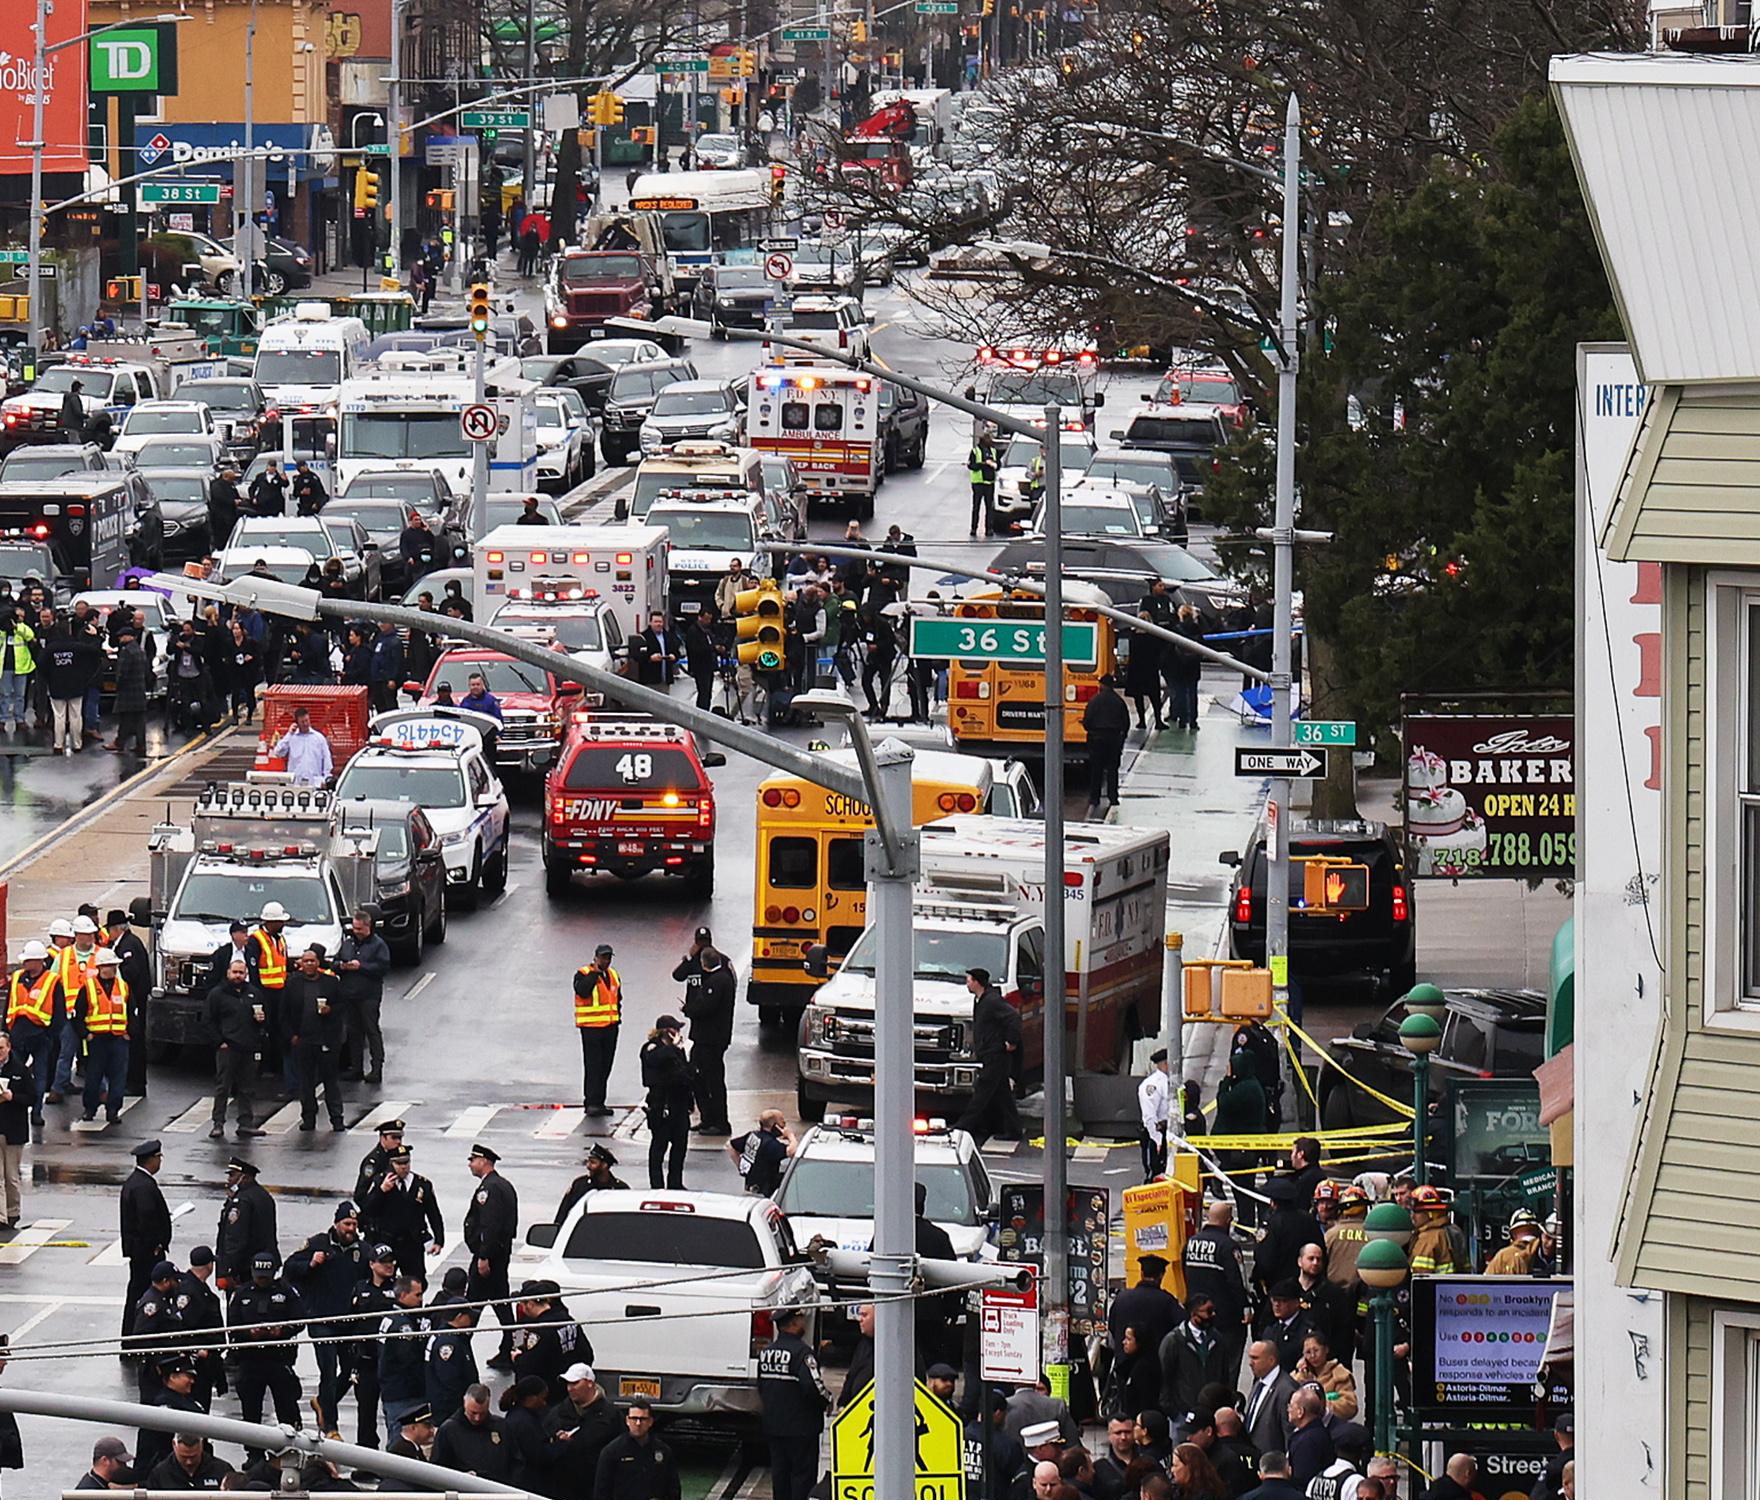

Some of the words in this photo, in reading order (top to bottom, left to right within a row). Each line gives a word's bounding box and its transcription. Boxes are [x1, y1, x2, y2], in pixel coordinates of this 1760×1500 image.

[96, 41, 152, 80] TD
[161, 188, 178, 200] 38
[185, 188, 201, 200] St
[782, 431, 841, 440] AMBULANCE
[959, 627, 998, 651] 36
[1302, 725, 1323, 742] 36
[1330, 724, 1347, 738] ST
[1248, 757, 1275, 768] ONE
[1286, 757, 1313, 768] WAY
[570, 800, 617, 821] FDNY
[1484, 794, 1534, 816] OPEN
[1540, 794, 1561, 816] 24
[1523, 1172, 1556, 1187] MEDICAL
[1187, 1239, 1216, 1253] NYPD
[1504, 1294, 1550, 1306] Brooklyn
[1511, 1307, 1550, 1318] incident
[1438, 1357, 1467, 1368] Buses
[1469, 1357, 1507, 1370] delayed
[1509, 1357, 1540, 1368] becau
[1438, 1371, 1482, 1382] response
[1485, 1370, 1523, 1381] vehicles
[1486, 1456, 1550, 1475] Street
